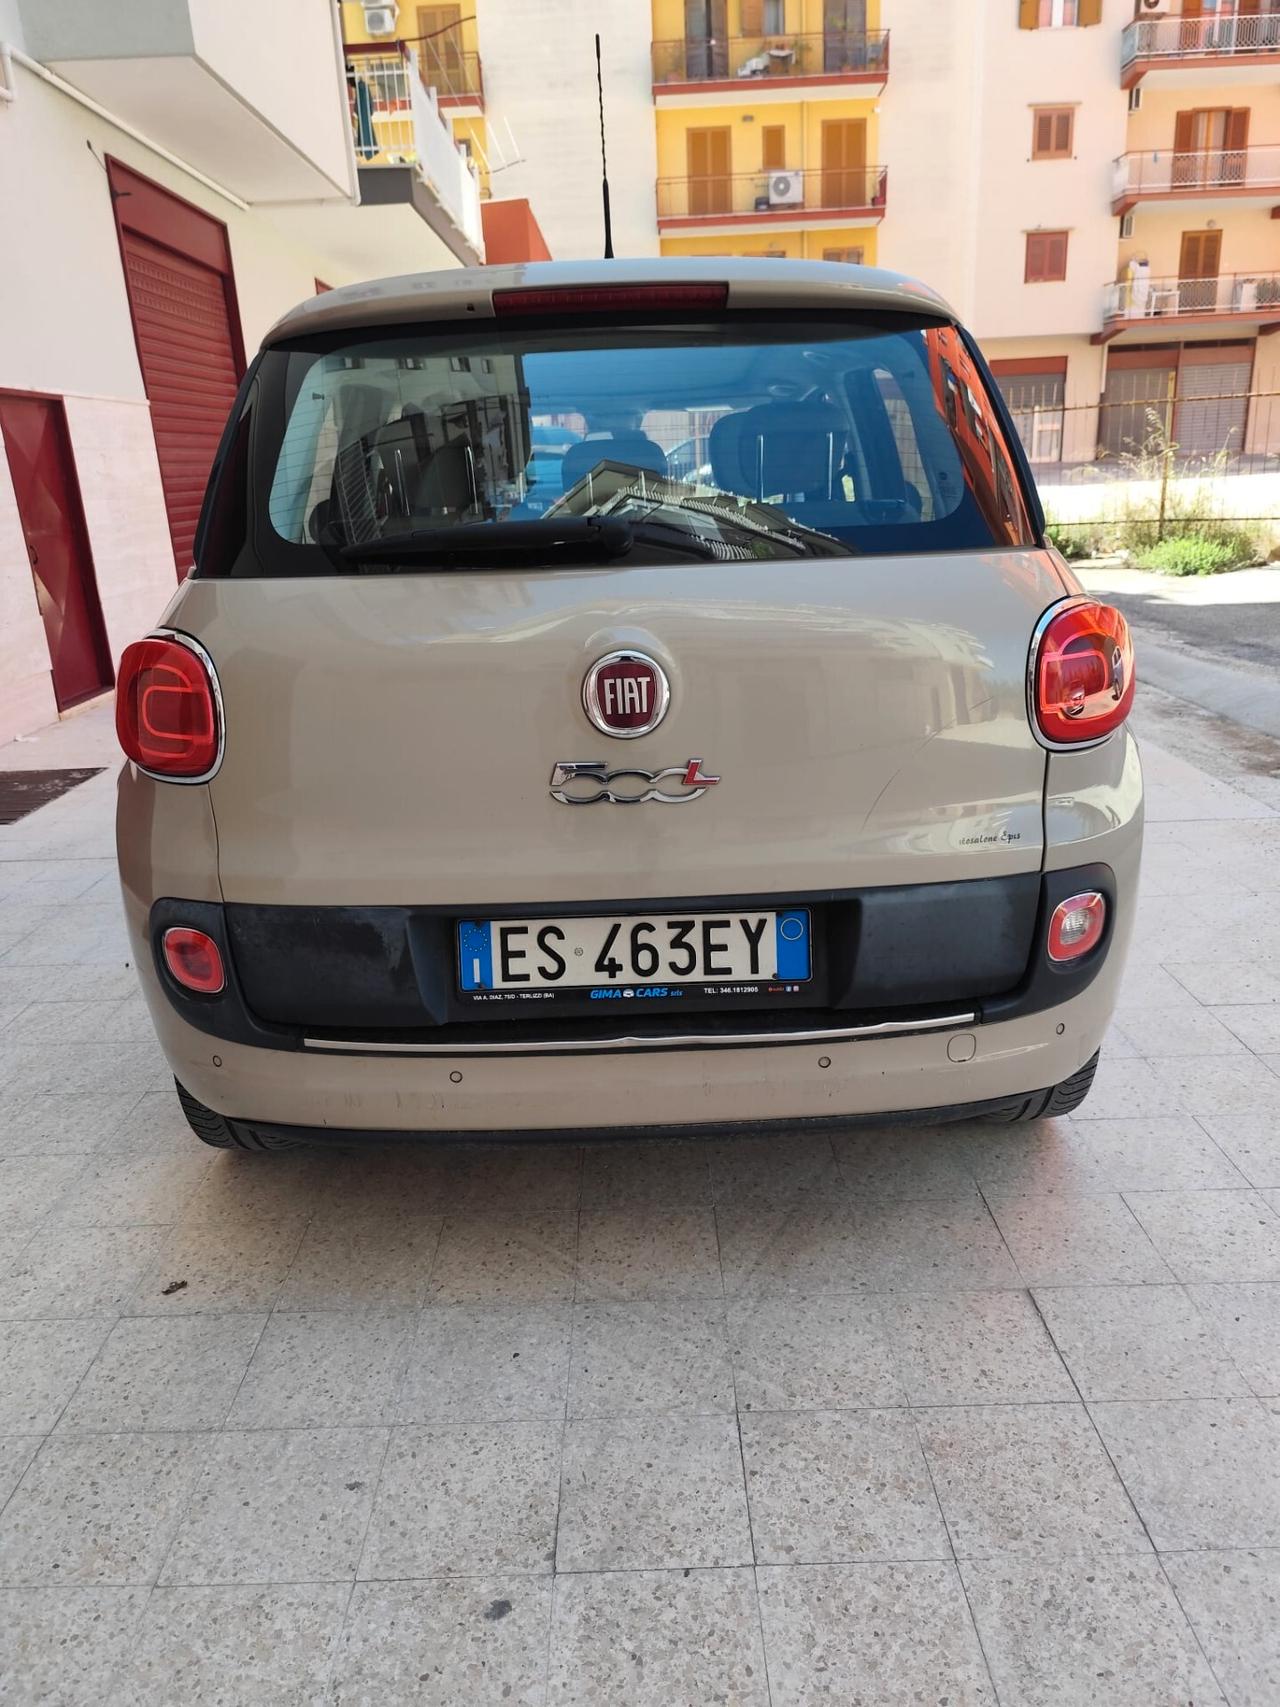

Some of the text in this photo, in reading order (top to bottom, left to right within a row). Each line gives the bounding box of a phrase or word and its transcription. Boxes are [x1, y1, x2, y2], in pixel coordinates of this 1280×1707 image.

[604, 677, 650, 715] FIAT
[550, 759, 721, 804] 500L
[500, 925, 566, 982] ES
[594, 918, 767, 978] 463EY
[590, 989, 622, 999] GIMA
[636, 987, 668, 998] CARS
